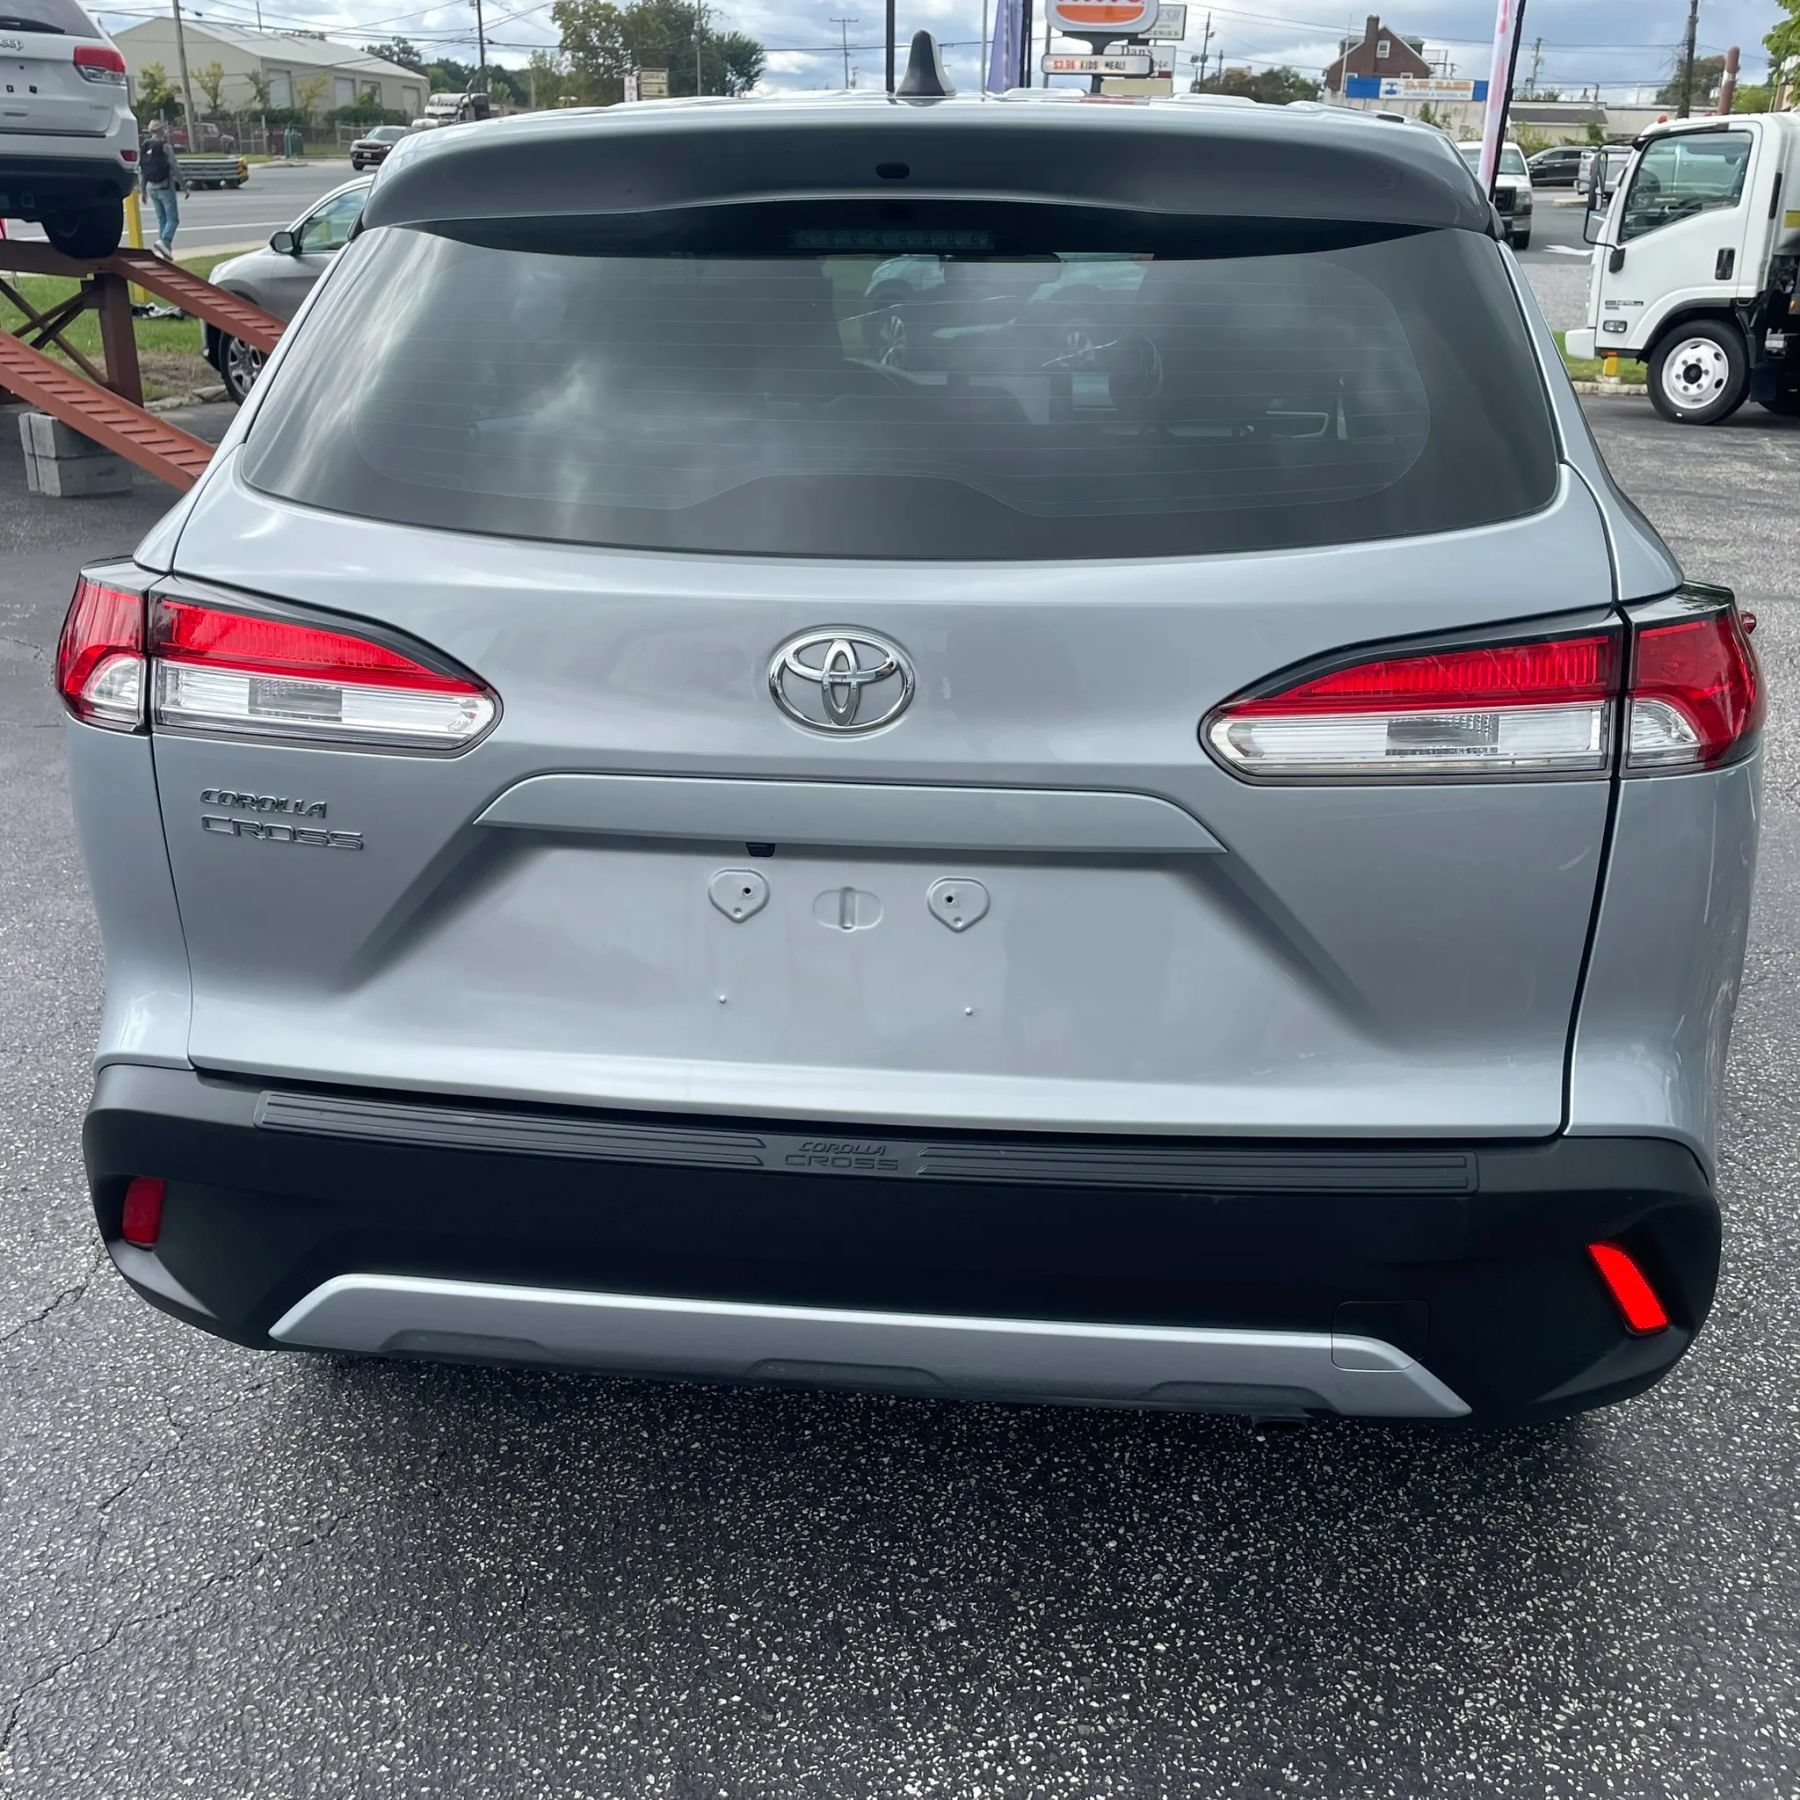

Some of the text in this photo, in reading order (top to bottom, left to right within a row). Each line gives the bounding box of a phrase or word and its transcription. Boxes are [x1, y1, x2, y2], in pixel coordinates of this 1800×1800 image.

[0, 39, 24, 52] eep
[1080, 60, 1099, 70] KIDS
[200, 788, 327, 819] COROLLA
[201, 814, 364, 850] CROSS
[798, 1141, 887, 1156] COROLLA
[785, 1154, 899, 1171] CROSS
